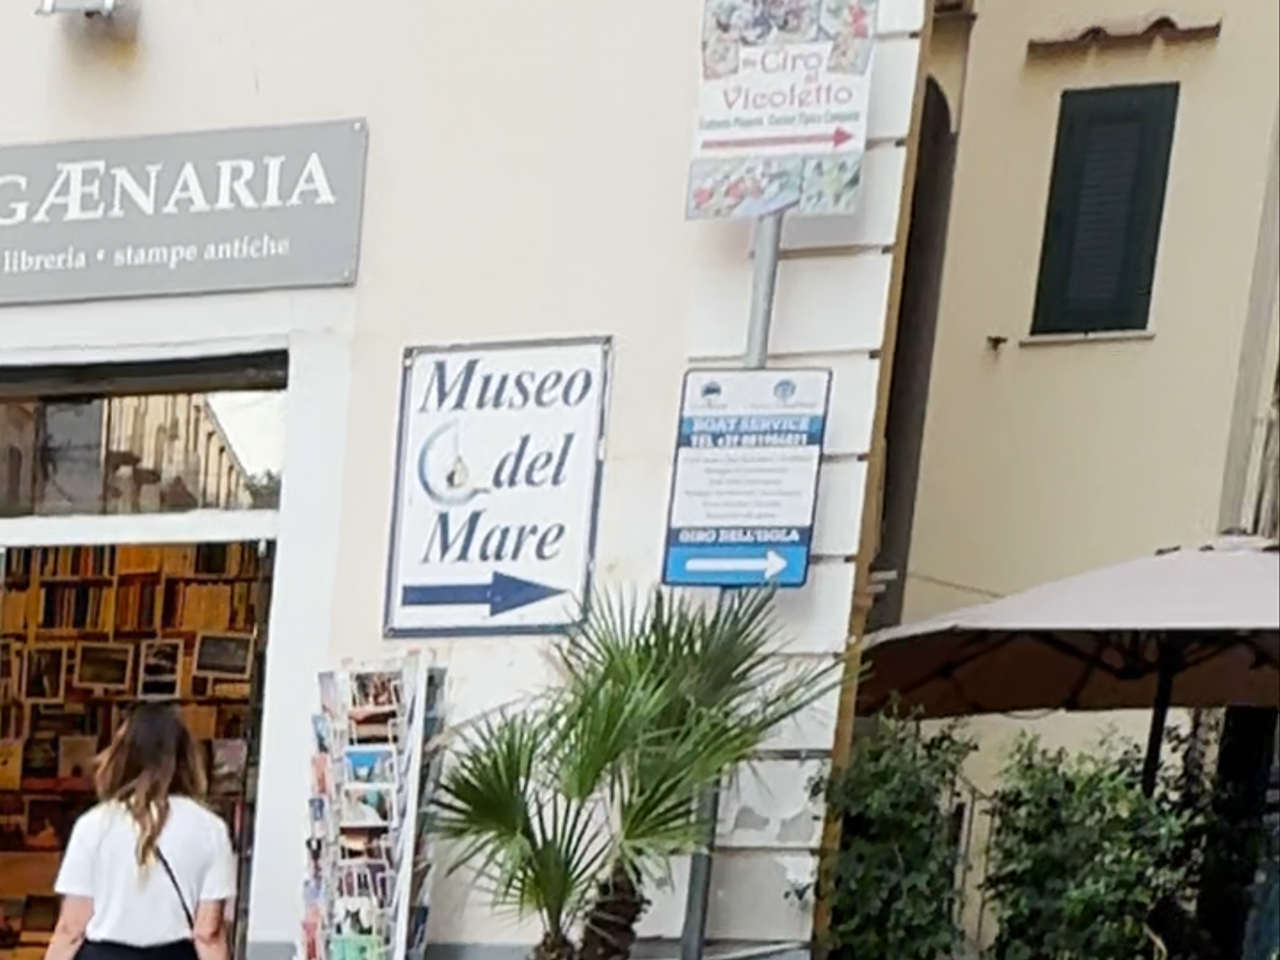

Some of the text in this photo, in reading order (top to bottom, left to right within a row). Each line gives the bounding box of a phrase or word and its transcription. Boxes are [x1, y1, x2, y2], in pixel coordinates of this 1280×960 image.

[723, 83, 854, 111] Vicoletto
[2, 245, 87, 272] libreria
[113, 240, 199, 272] stampe
[203, 233, 291, 261] antiche
[417, 357, 593, 413] Museo
[739, 415, 809, 432] SERVICE
[491, 431, 576, 490] del
[420, 507, 566, 565] Mare
